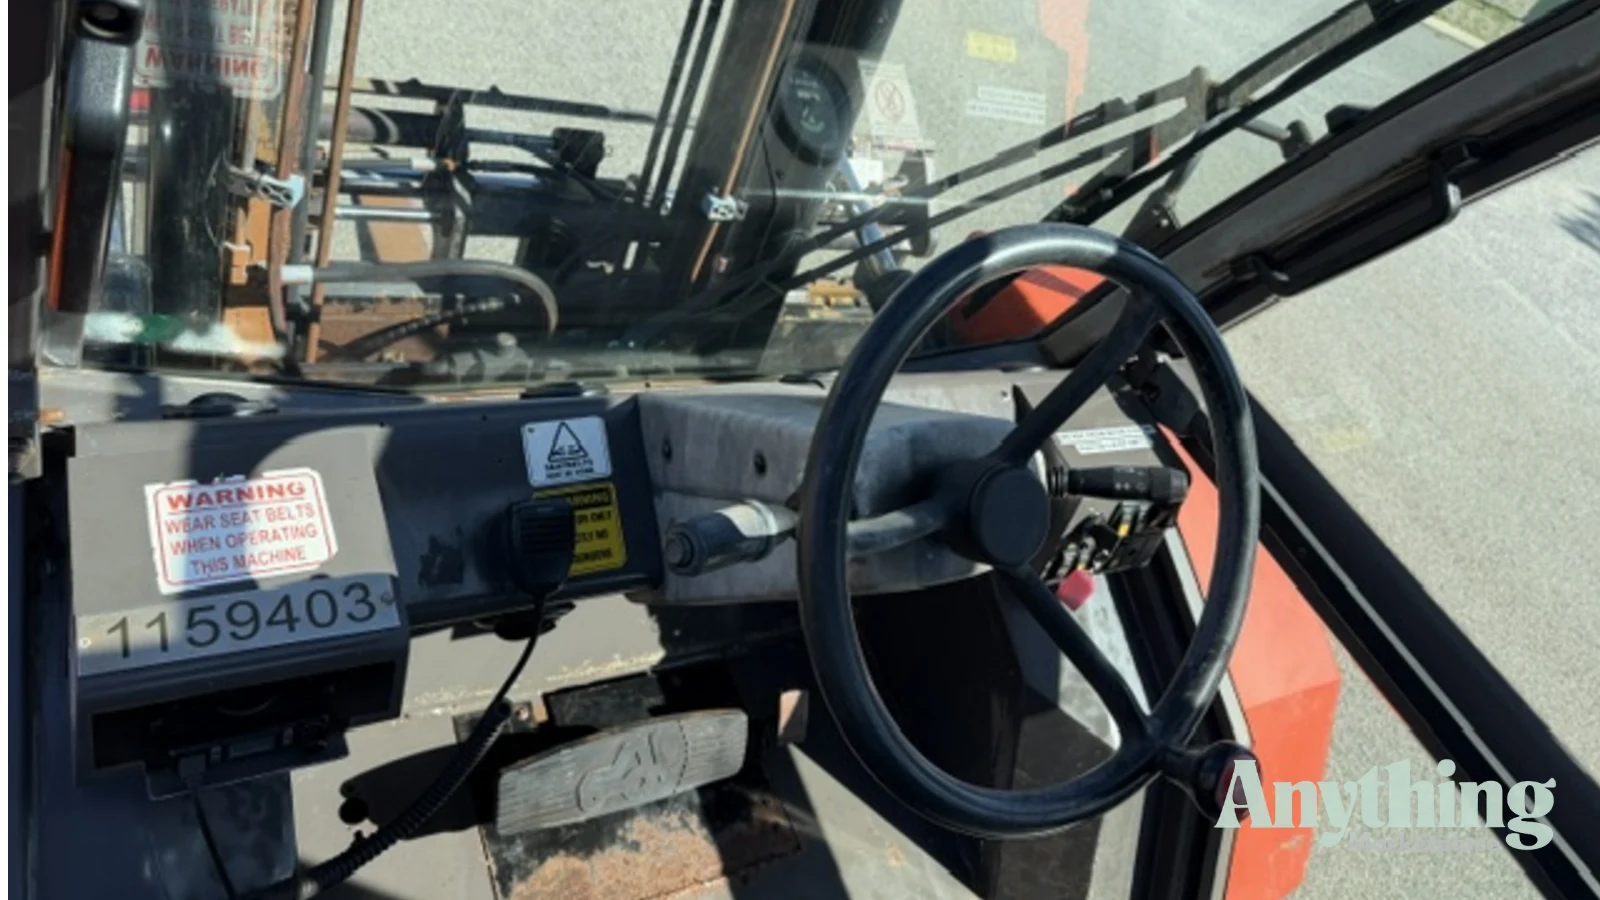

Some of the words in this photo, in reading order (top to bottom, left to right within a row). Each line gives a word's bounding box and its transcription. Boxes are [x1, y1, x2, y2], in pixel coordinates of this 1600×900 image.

[167, 482, 306, 509] WARNING
[166, 516, 216, 533] WEAR
[220, 510, 263, 528] SEAT
[265, 503, 315, 522] BELTS
[170, 536, 221, 556] WHEN
[225, 523, 317, 548] OPERATING
[190, 557, 229, 575] THIS
[233, 546, 307, 568] MACHINE
[107, 582, 376, 658] 1159403
